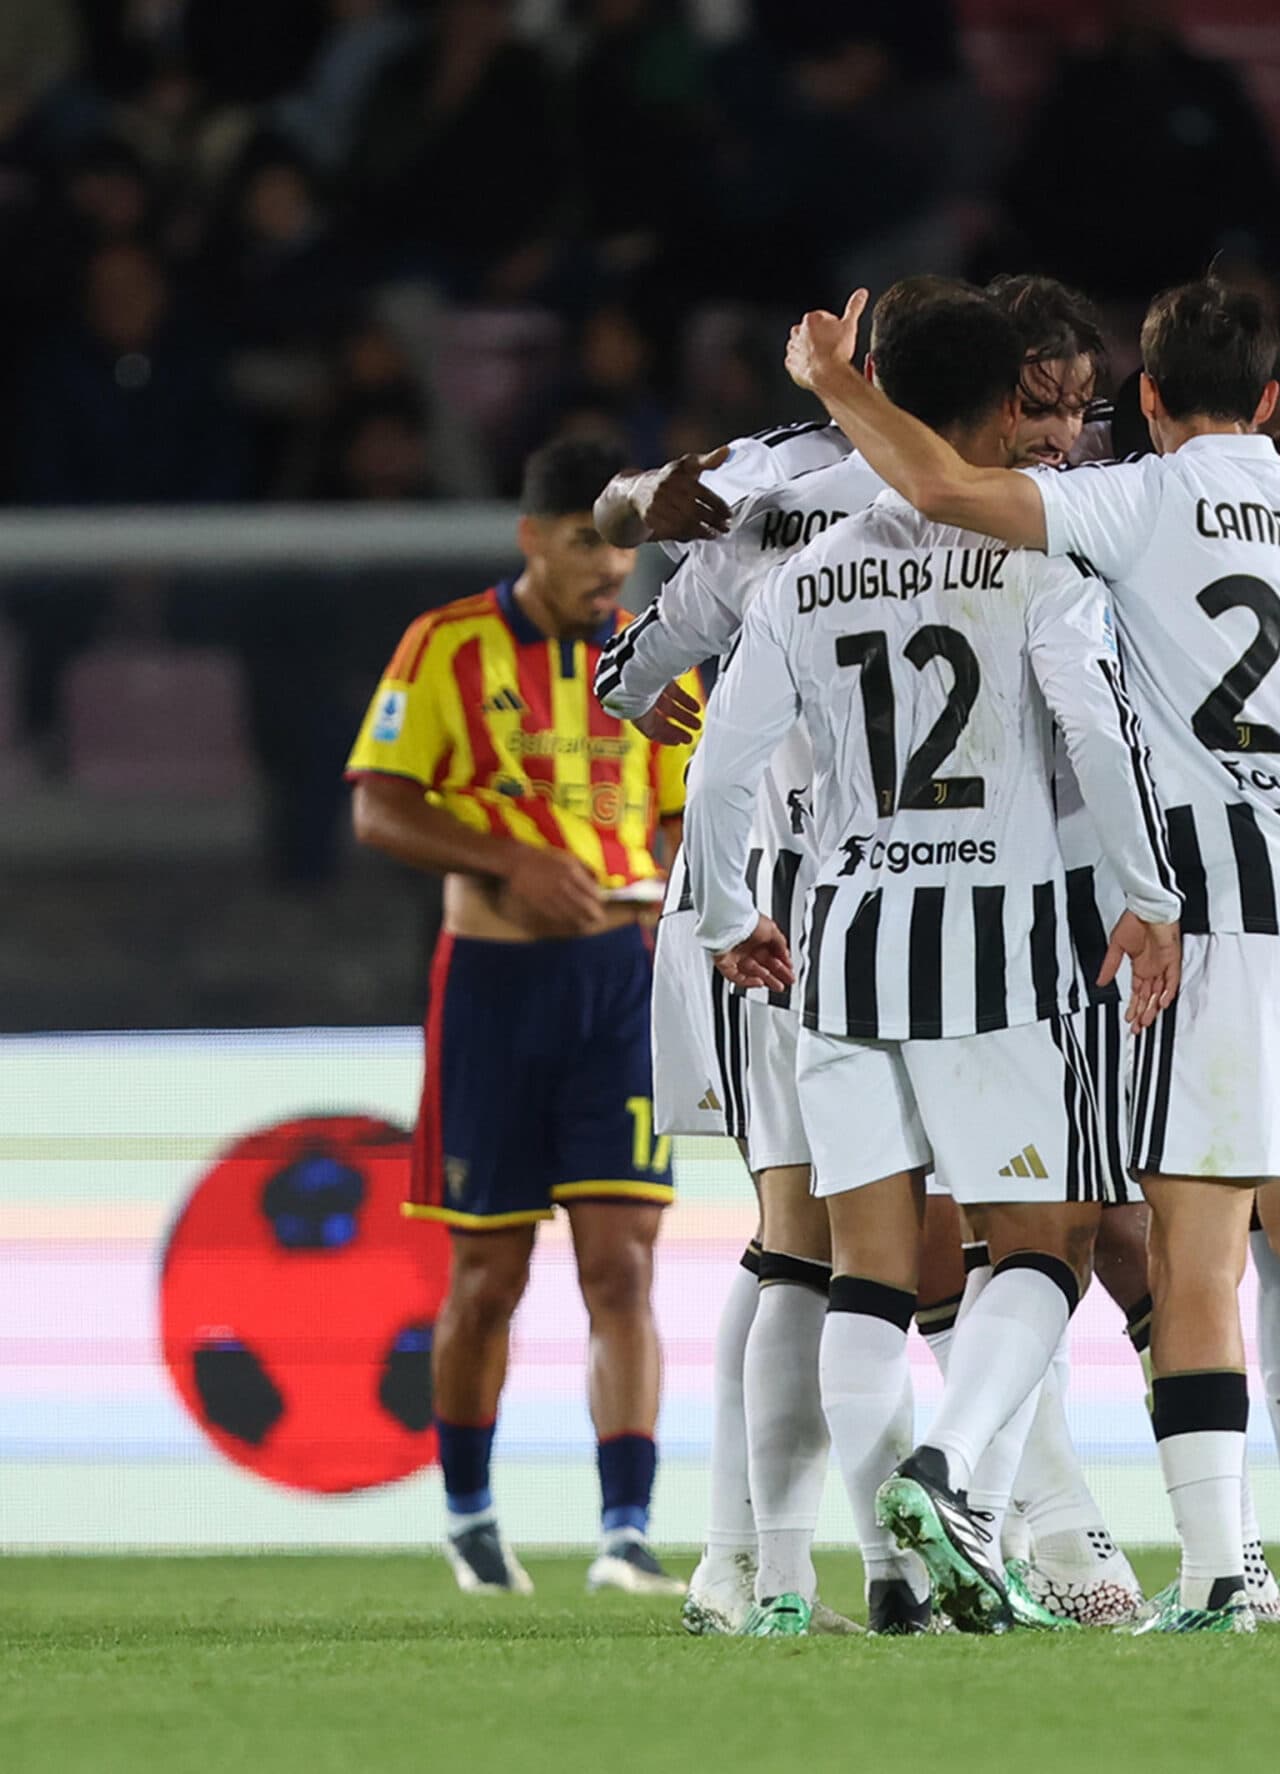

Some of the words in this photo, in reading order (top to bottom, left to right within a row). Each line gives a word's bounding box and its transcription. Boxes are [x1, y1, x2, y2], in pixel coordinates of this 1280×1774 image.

[797, 552, 933, 614] DOUGLAS
[943, 548, 1010, 591] LUIZ
[835, 624, 985, 818] 12
